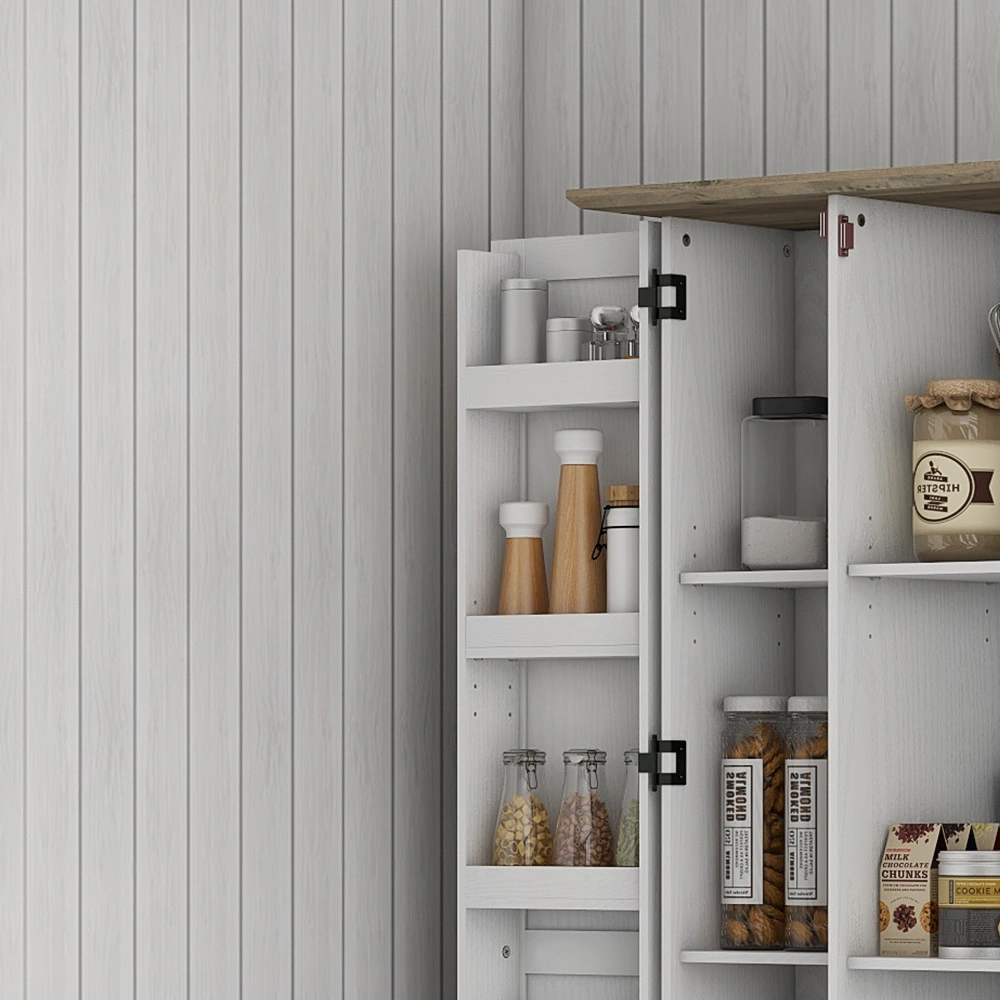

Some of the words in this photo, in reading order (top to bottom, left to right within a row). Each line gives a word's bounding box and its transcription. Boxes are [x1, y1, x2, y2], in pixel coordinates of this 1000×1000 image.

[884, 853, 910, 861] MILK
[881, 869, 928, 879] CHUNKS
[956, 887, 991, 895] COOKIE
